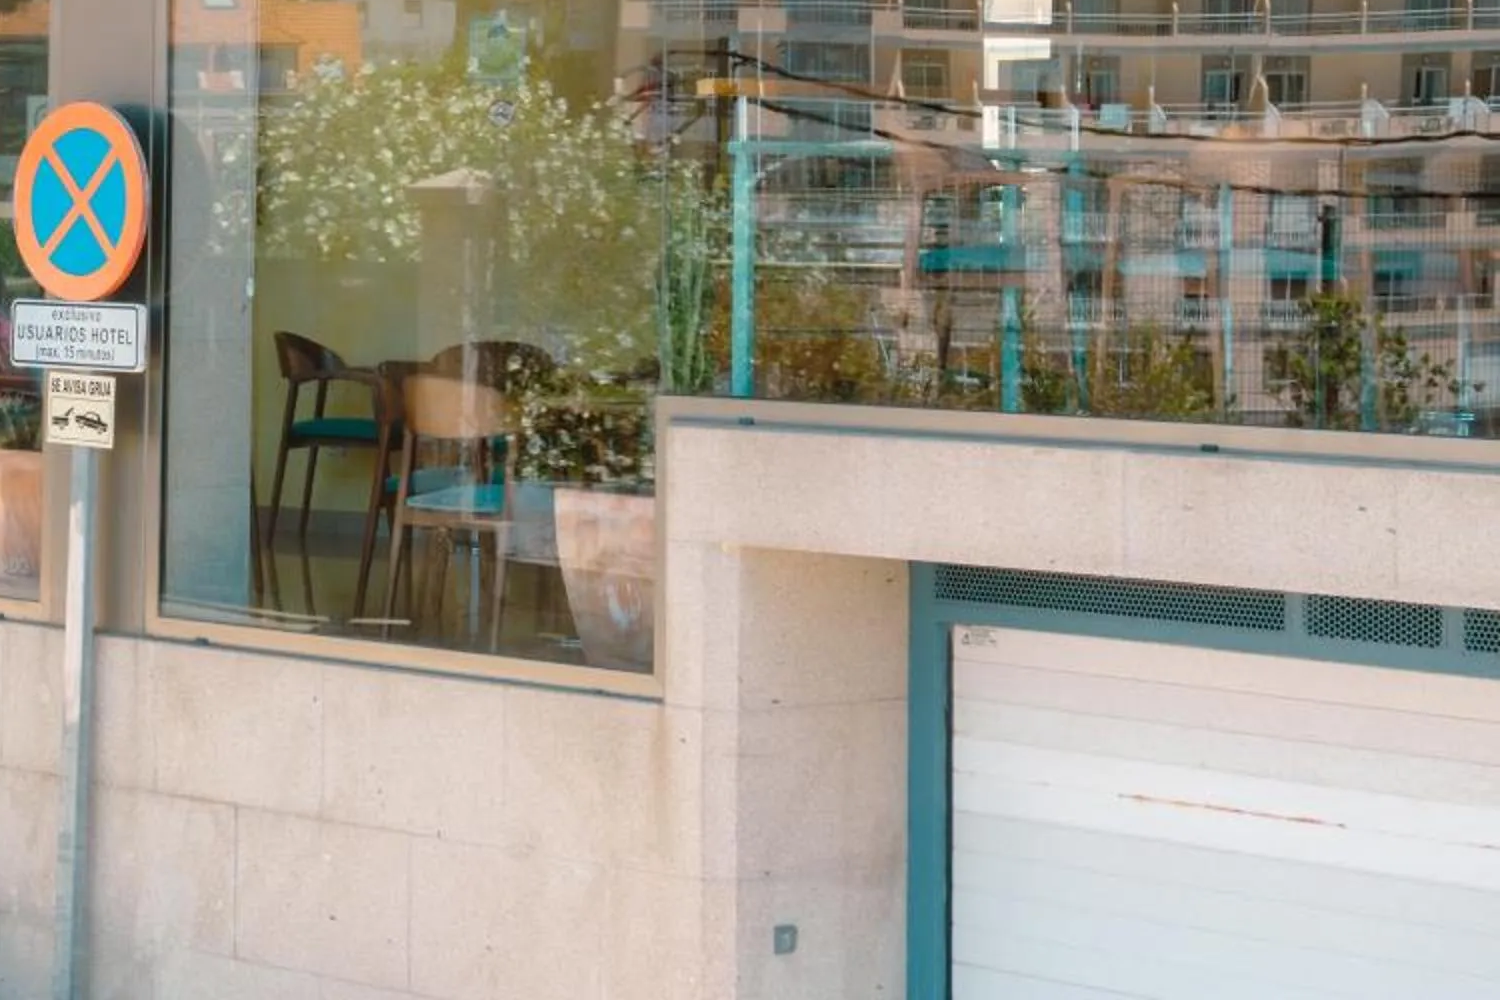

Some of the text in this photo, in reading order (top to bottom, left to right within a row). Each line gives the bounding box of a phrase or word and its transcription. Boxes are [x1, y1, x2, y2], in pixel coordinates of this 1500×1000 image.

[17, 324, 133, 345] USUARIOS HOTEL
[63, 345, 75, 359] 15
[51, 377, 61, 393] SE
